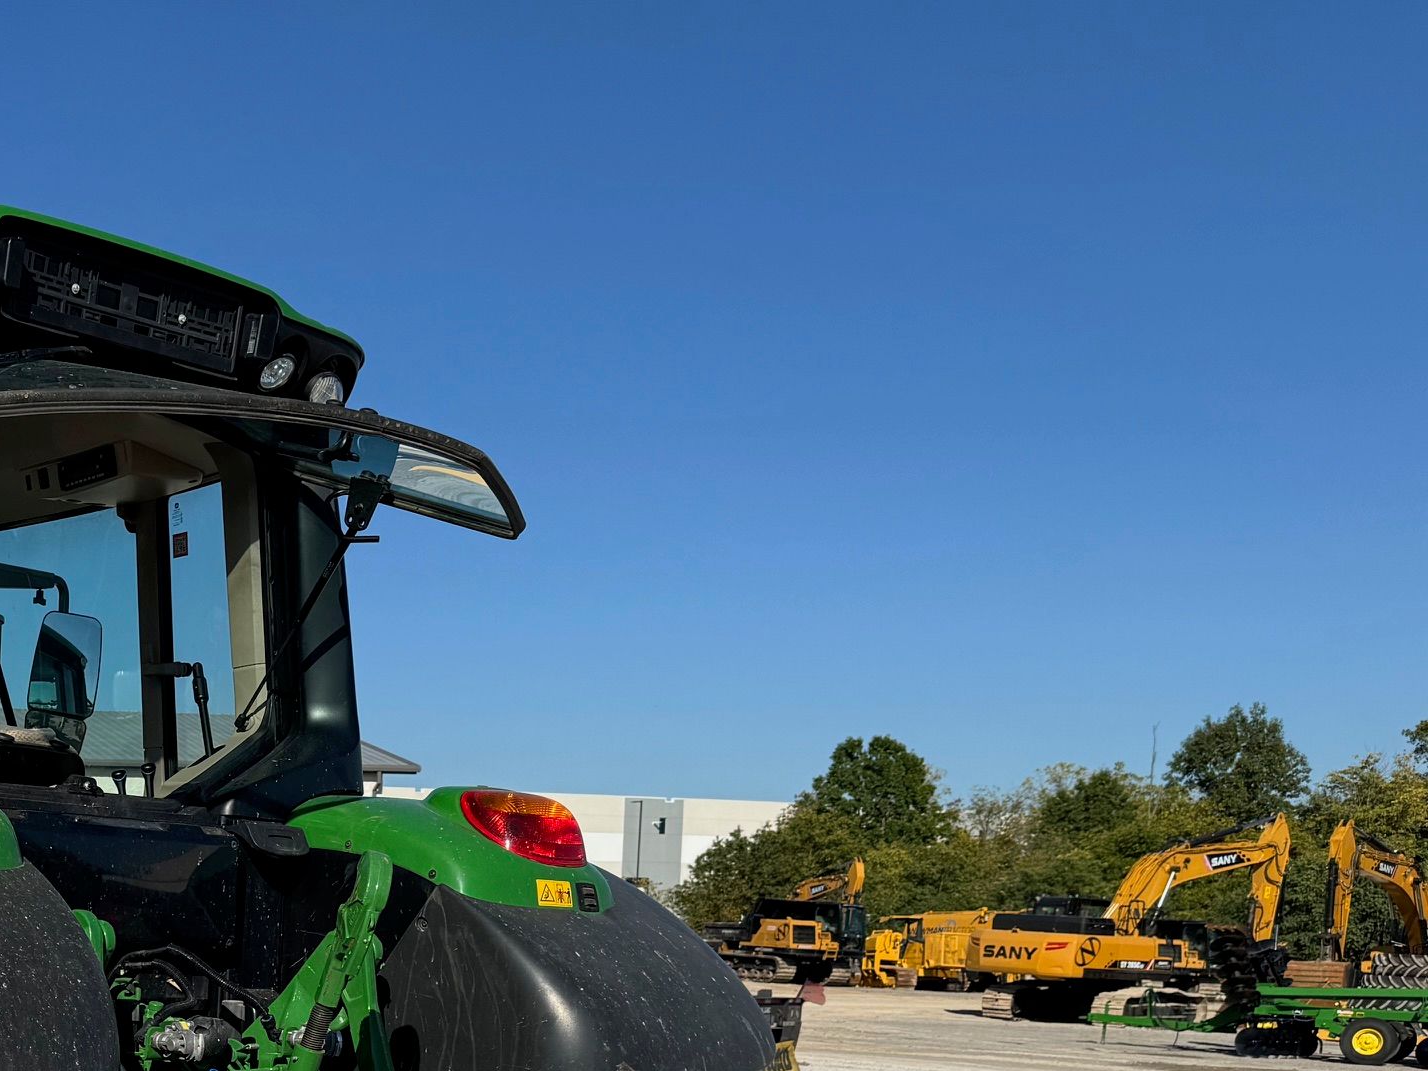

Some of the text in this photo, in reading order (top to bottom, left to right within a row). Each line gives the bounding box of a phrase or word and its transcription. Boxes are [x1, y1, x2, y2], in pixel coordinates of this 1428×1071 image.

[1211, 854, 1237, 867] SANY
[1379, 862, 1394, 874] SANY
[983, 945, 1038, 960] SANY
